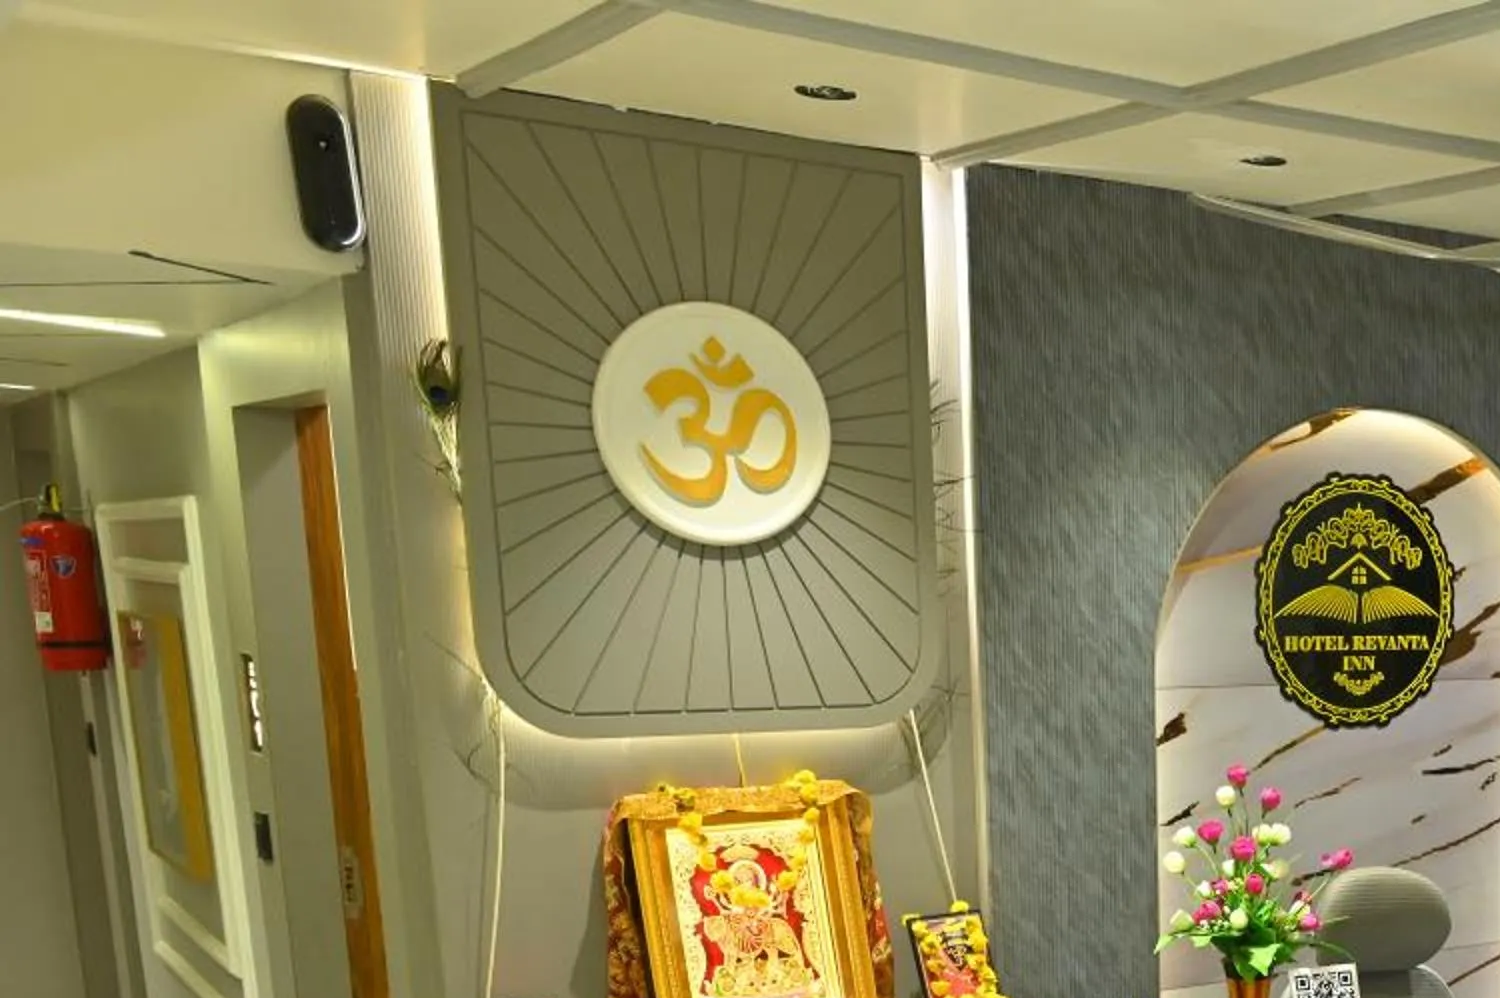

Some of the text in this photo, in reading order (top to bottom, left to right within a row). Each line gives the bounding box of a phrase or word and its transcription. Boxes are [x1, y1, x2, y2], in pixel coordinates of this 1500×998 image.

[1284, 635, 1430, 651] HOTEL REVANTA
[1343, 655, 1376, 671] INN
